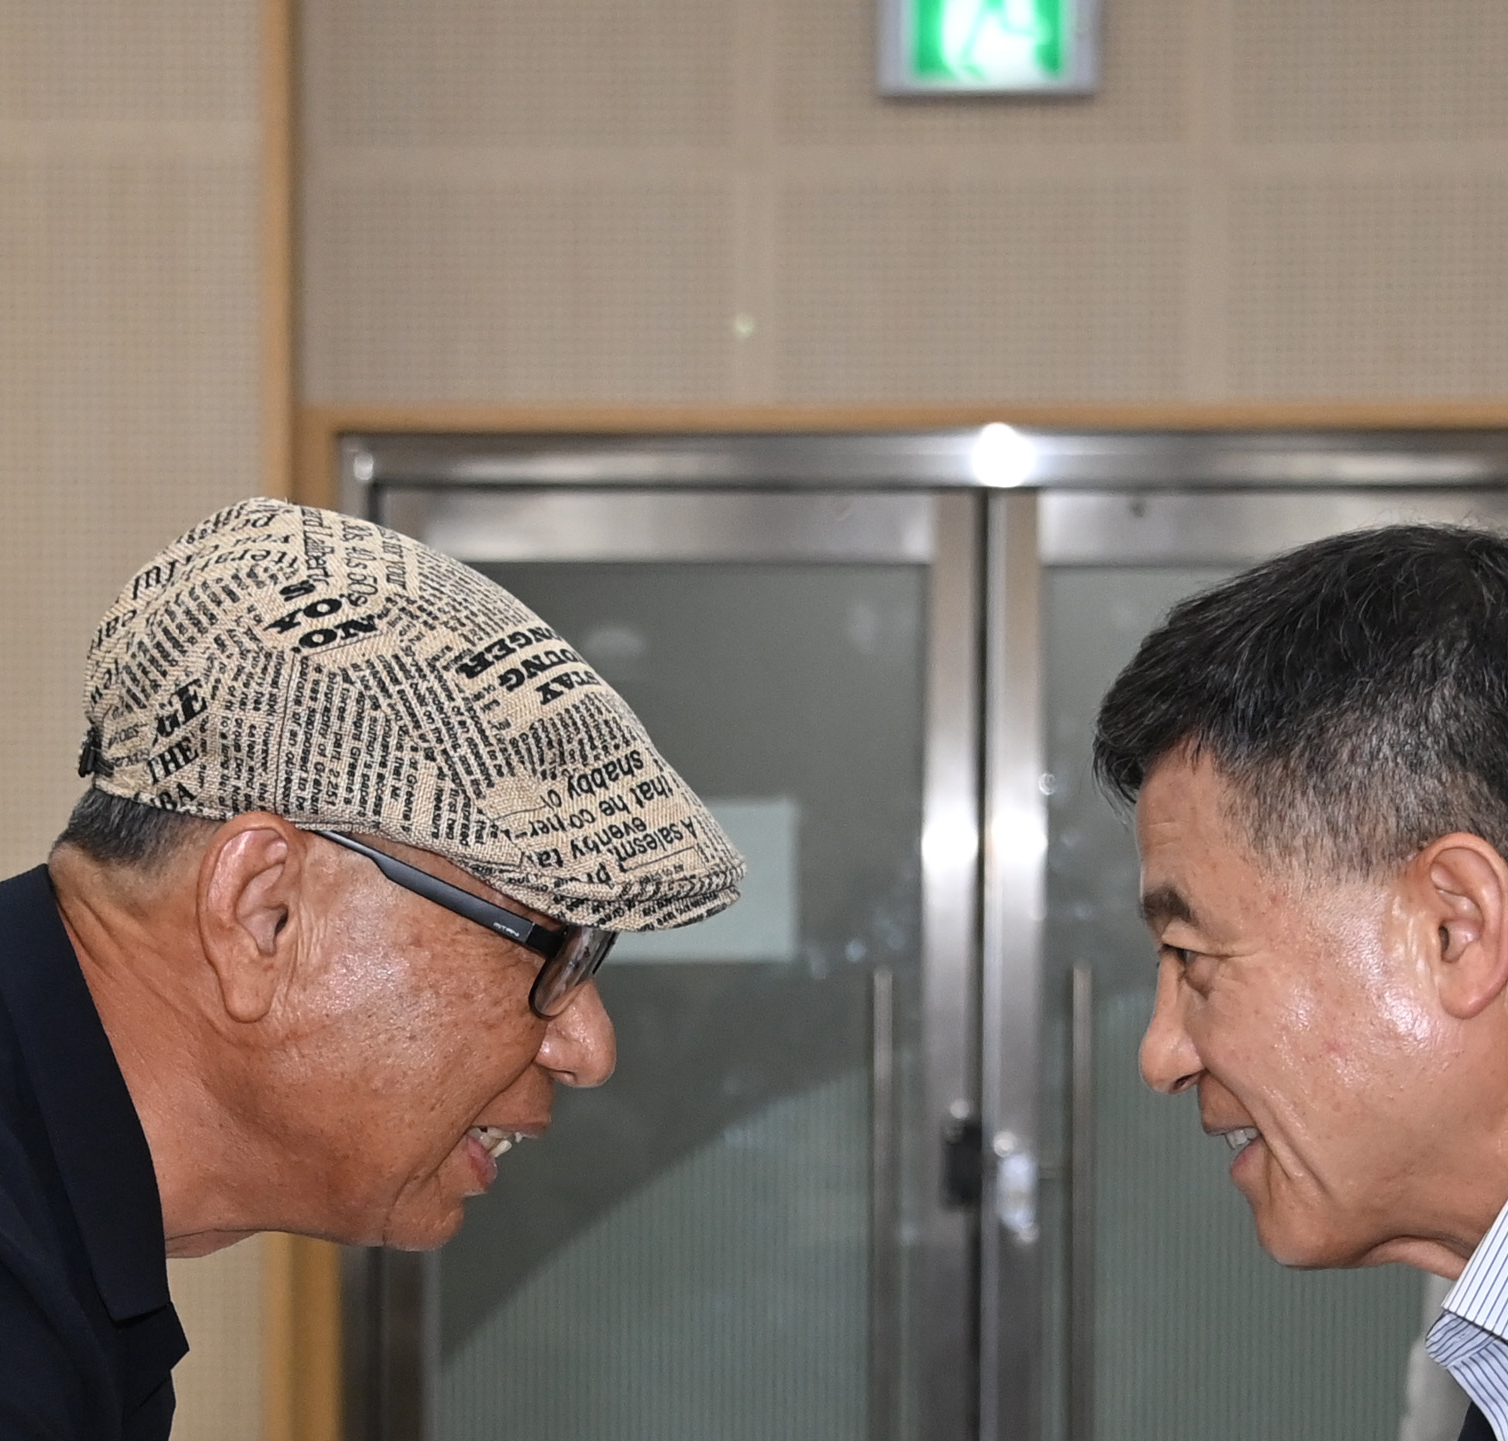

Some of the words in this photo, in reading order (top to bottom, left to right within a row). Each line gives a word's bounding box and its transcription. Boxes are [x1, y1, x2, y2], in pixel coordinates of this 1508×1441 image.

[536, 670, 601, 705] STAY
[148, 737, 199, 784] THE
[567, 750, 644, 799] shabby
[598, 795, 631, 817] he
